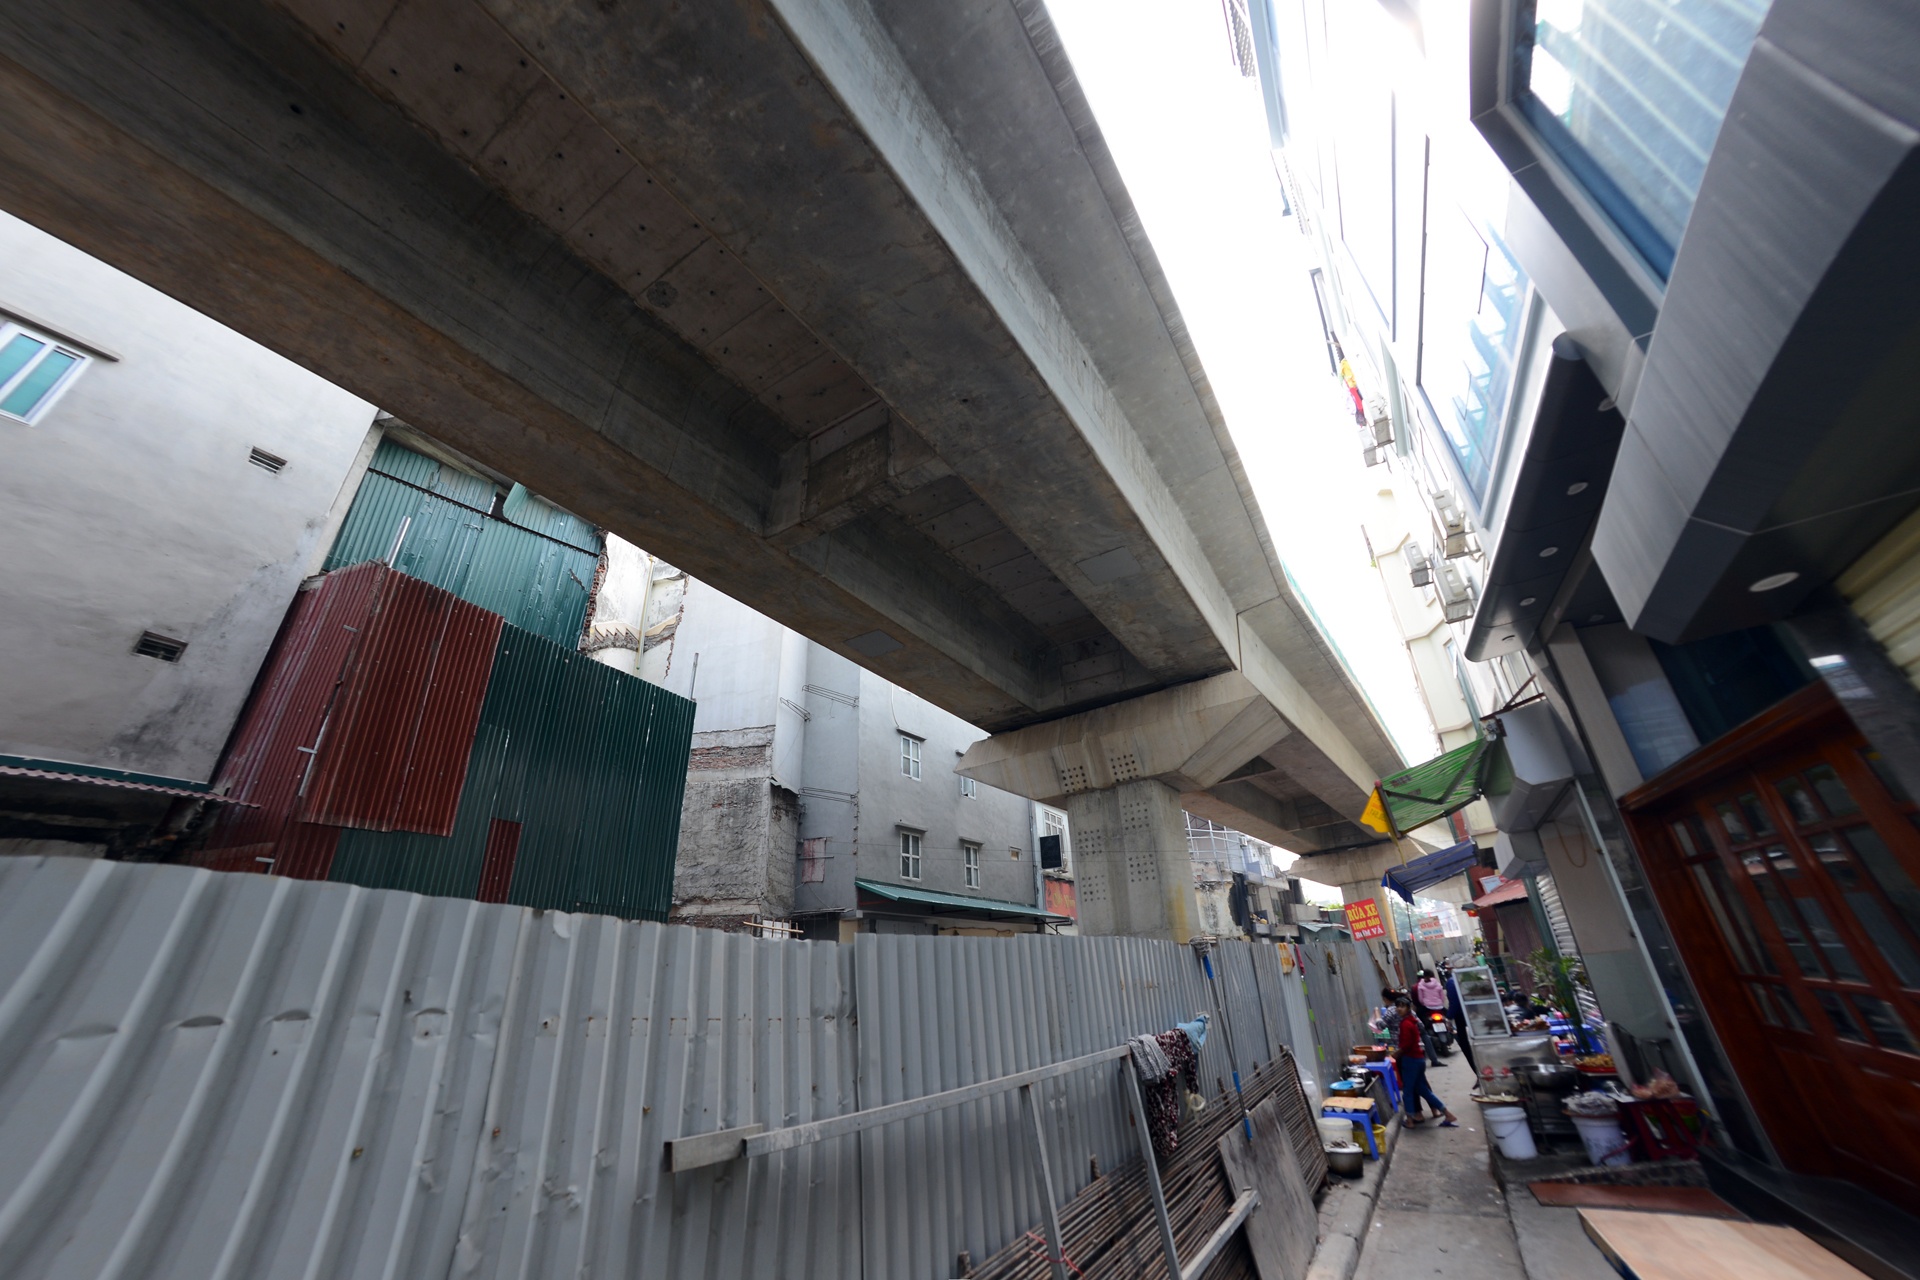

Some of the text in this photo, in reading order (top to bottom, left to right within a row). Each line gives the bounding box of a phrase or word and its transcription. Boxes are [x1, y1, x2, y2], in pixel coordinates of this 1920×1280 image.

[1347, 903, 1378, 921] RỬA XE
[1352, 921, 1367, 930] THAY
[1371, 925, 1384, 935] VÁ
